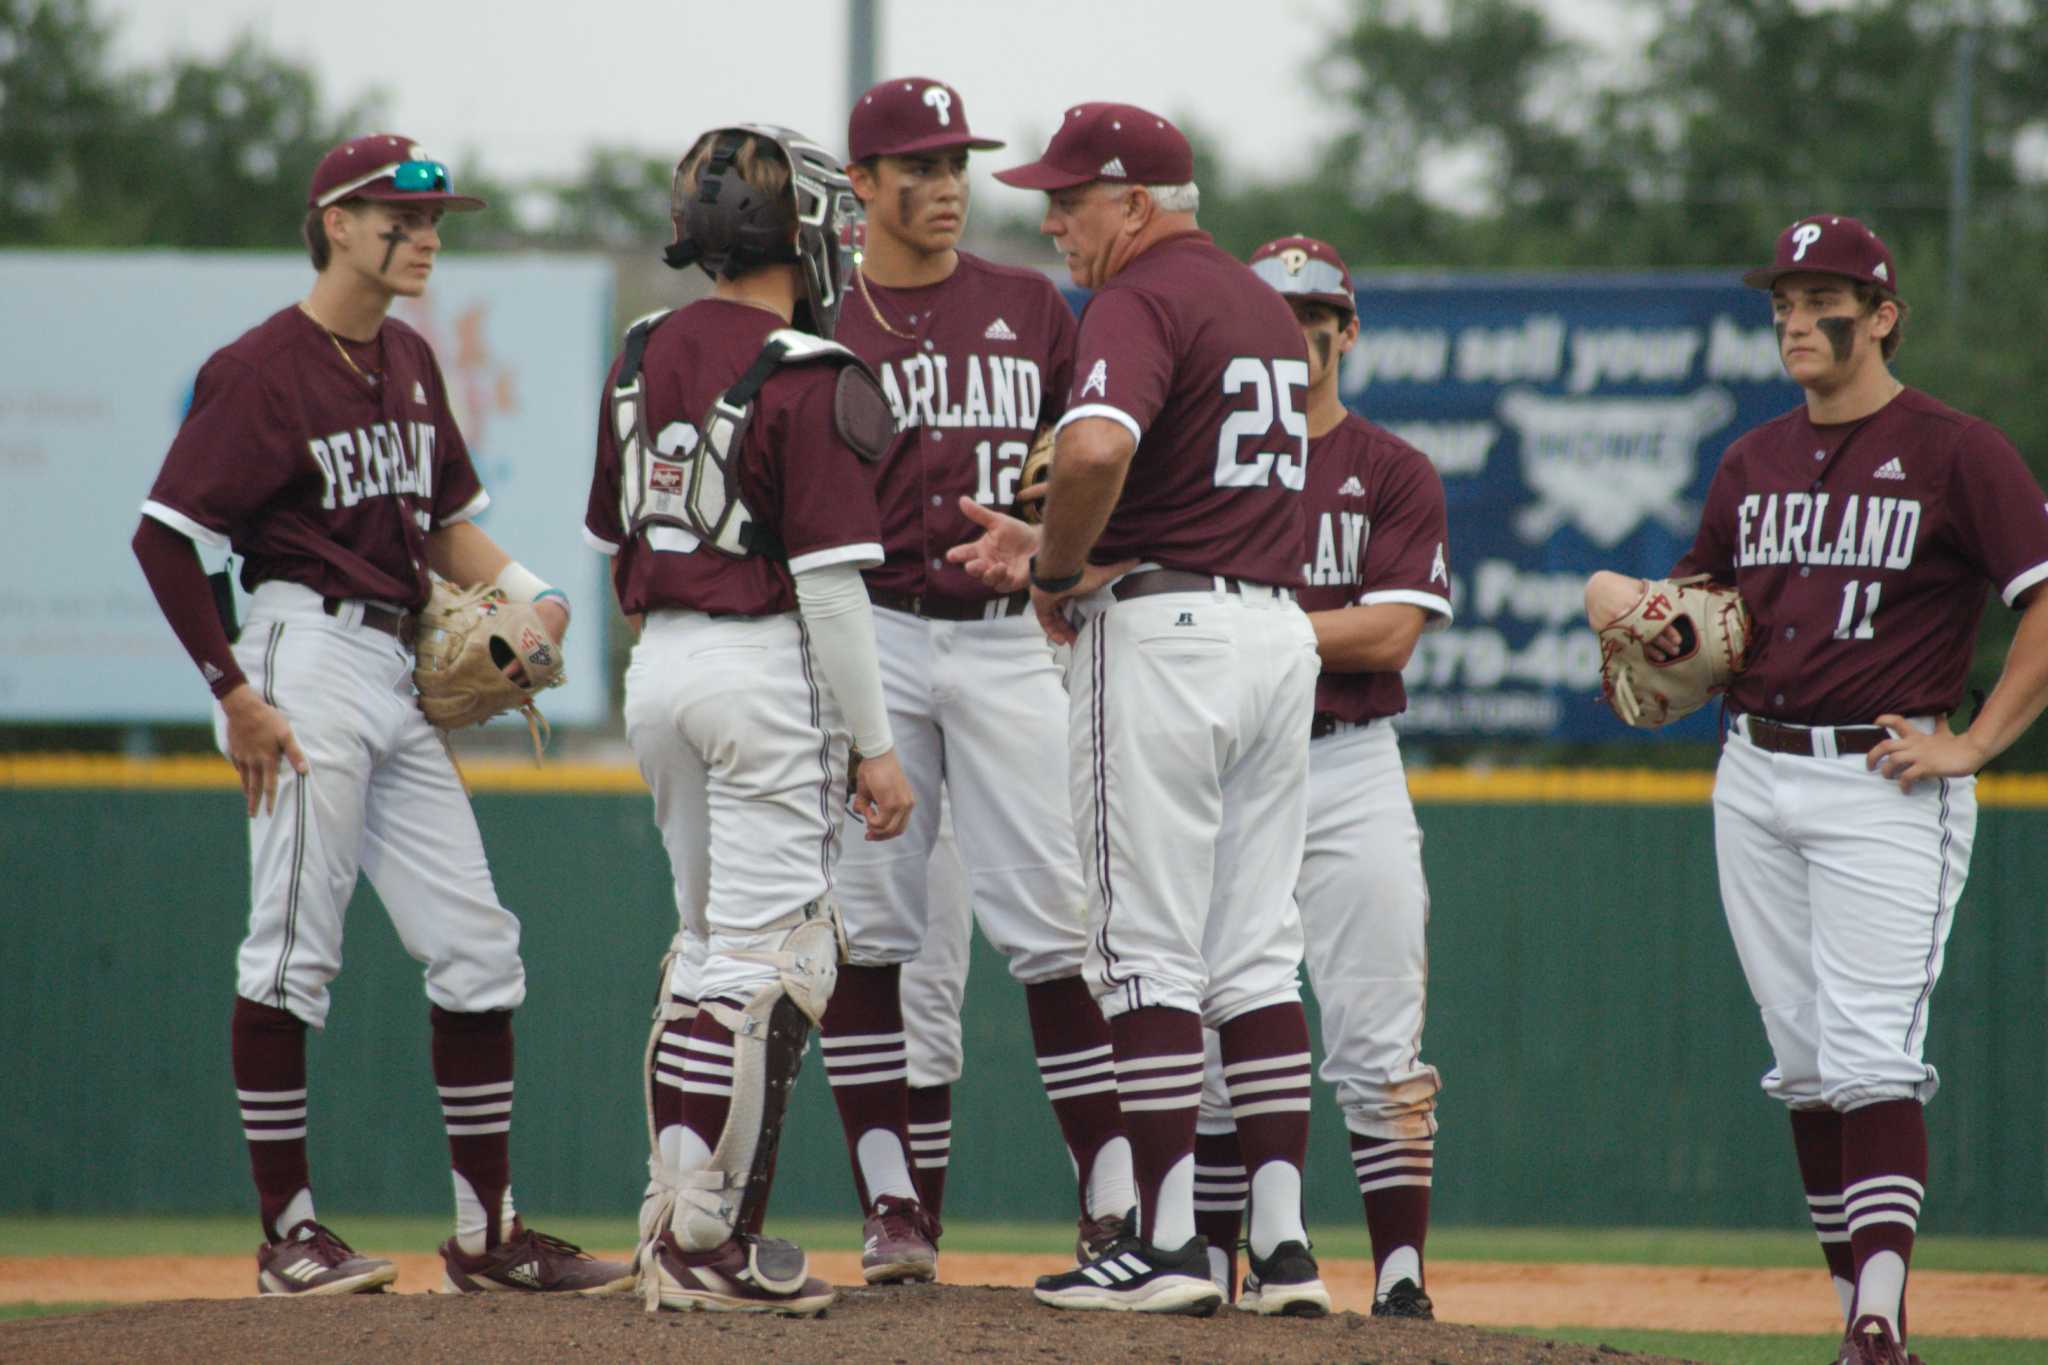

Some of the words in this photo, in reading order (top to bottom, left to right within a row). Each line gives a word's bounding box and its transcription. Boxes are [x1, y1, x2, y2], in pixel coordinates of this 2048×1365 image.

[922, 85, 951, 127] P
[1792, 223, 1822, 262] P
[1456, 315, 1564, 380] sell
[1568, 325, 1698, 392] your
[1706, 312, 1790, 381] ho
[1214, 357, 1309, 491] 25
[975, 440, 1028, 505] 12
[1733, 492, 1922, 570] EARLAND
[1833, 580, 1882, 639] 11
